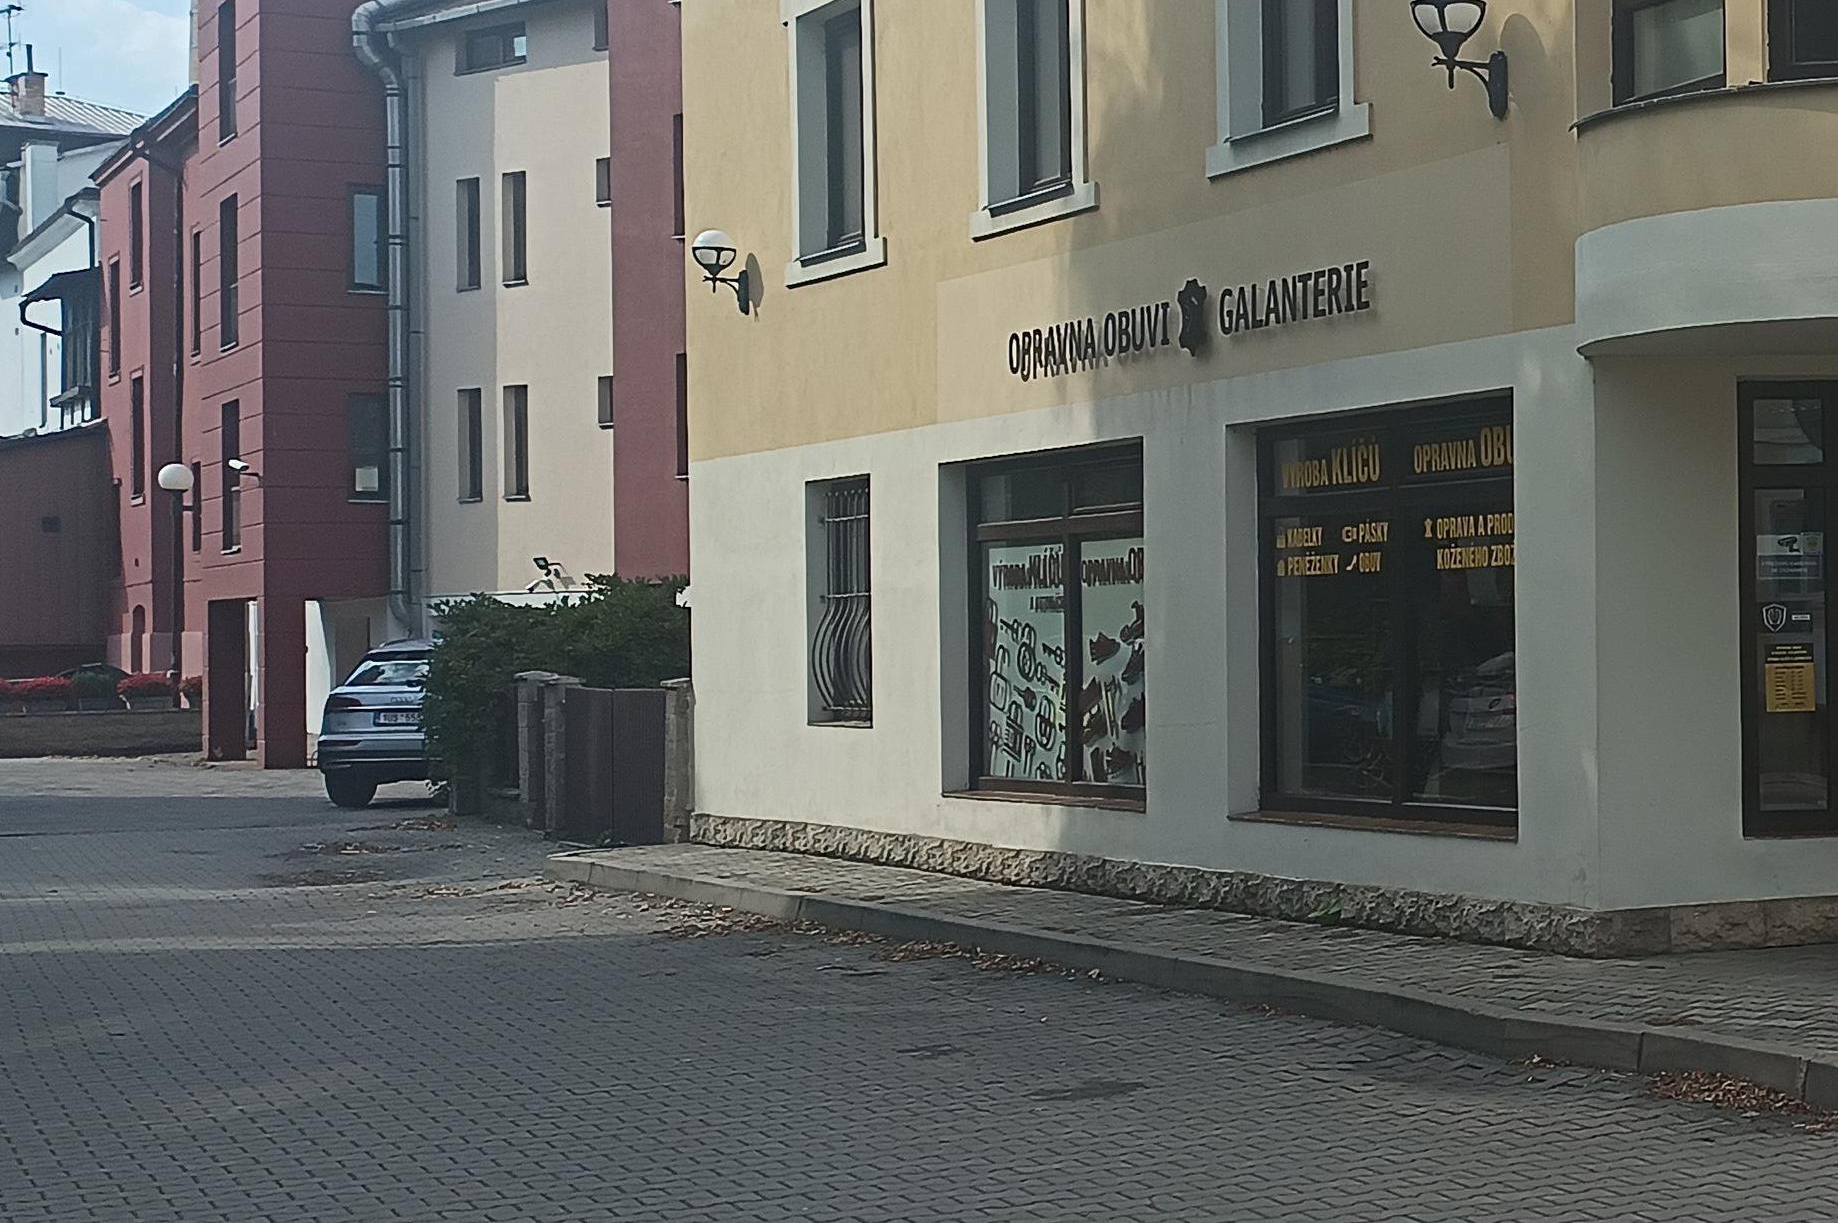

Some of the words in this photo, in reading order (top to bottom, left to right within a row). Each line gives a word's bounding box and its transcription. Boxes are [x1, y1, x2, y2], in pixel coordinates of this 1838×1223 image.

[1218, 260, 1371, 336] GALANTERIE
[1008, 317, 1097, 377] OPRAVNA
[1104, 301, 1170, 357] OBUVI
[1331, 436, 1381, 485] KLÍČŮ
[1413, 439, 1477, 474] OPRAVNA
[1358, 519, 1389, 544] PÁSKY
[1436, 515, 1476, 539] OPRAVA
[1477, 515, 1486, 536] A
[1287, 551, 1340, 576] PENĚŽENKY
[1436, 541, 1489, 570] KOŽENÉHO
